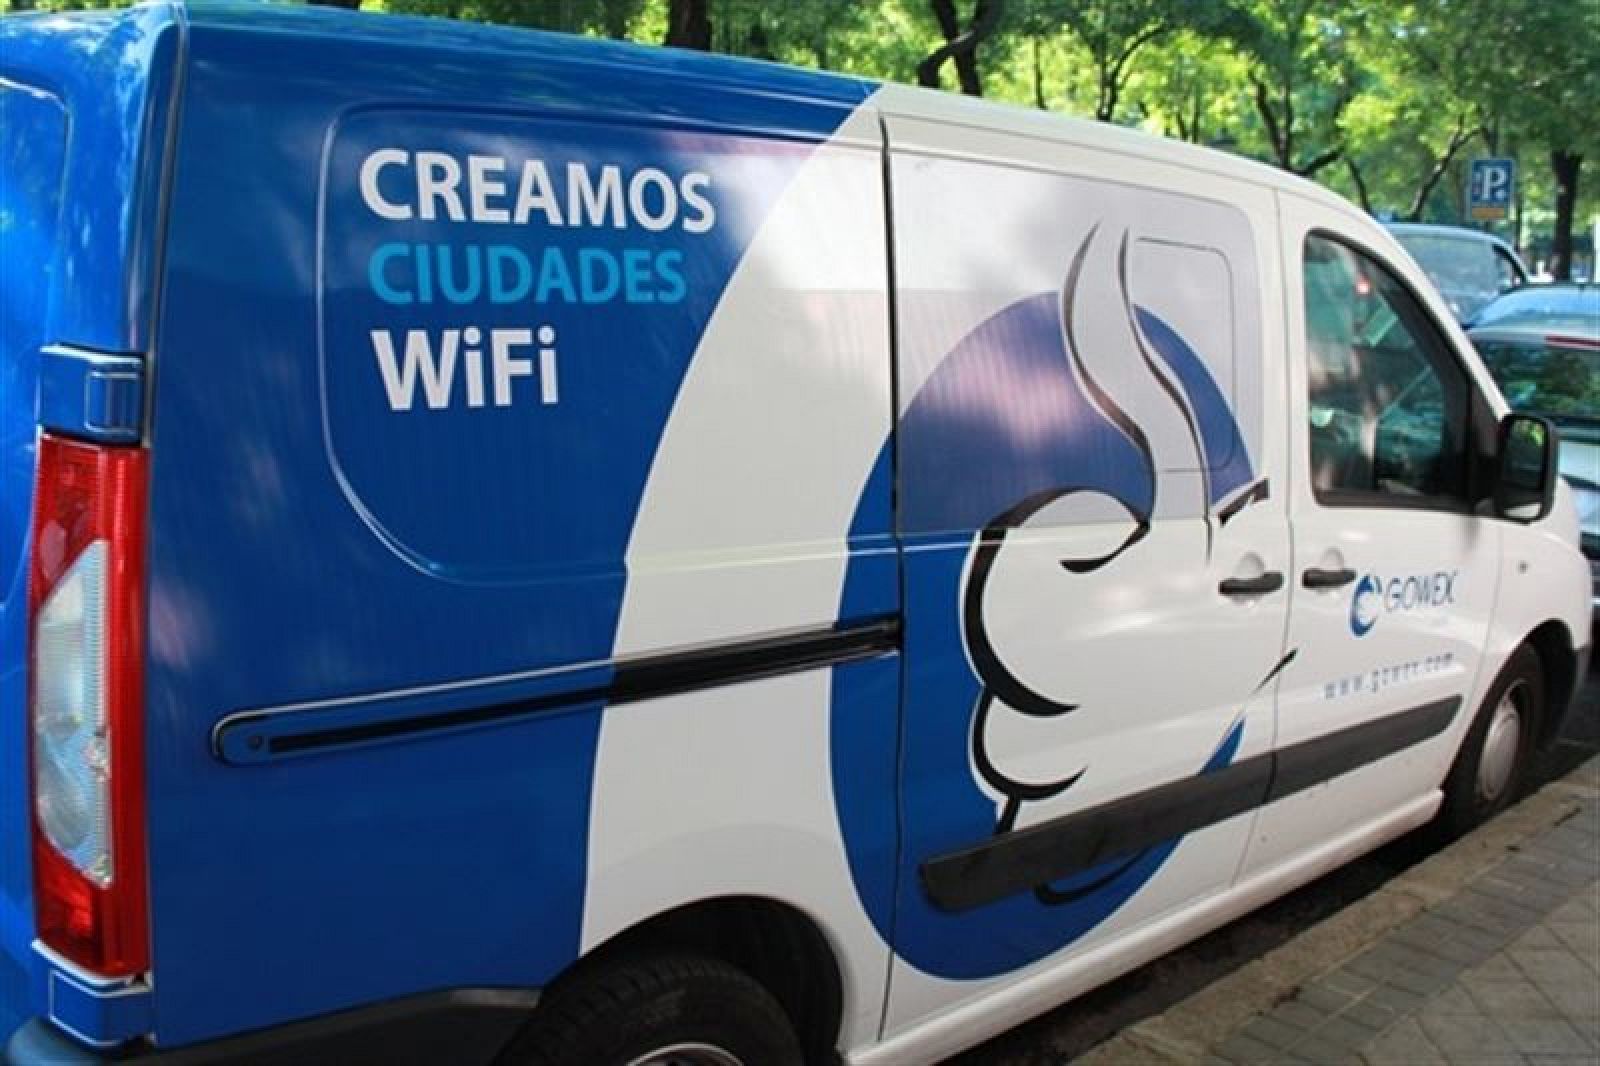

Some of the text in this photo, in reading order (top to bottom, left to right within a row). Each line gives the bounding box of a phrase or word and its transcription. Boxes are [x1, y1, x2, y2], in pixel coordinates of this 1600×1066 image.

[359, 147, 716, 233] CREAMOS
[367, 242, 688, 305] CIUDADES
[370, 326, 560, 411] WiFi
[1383, 569, 1458, 613] GOWEX
